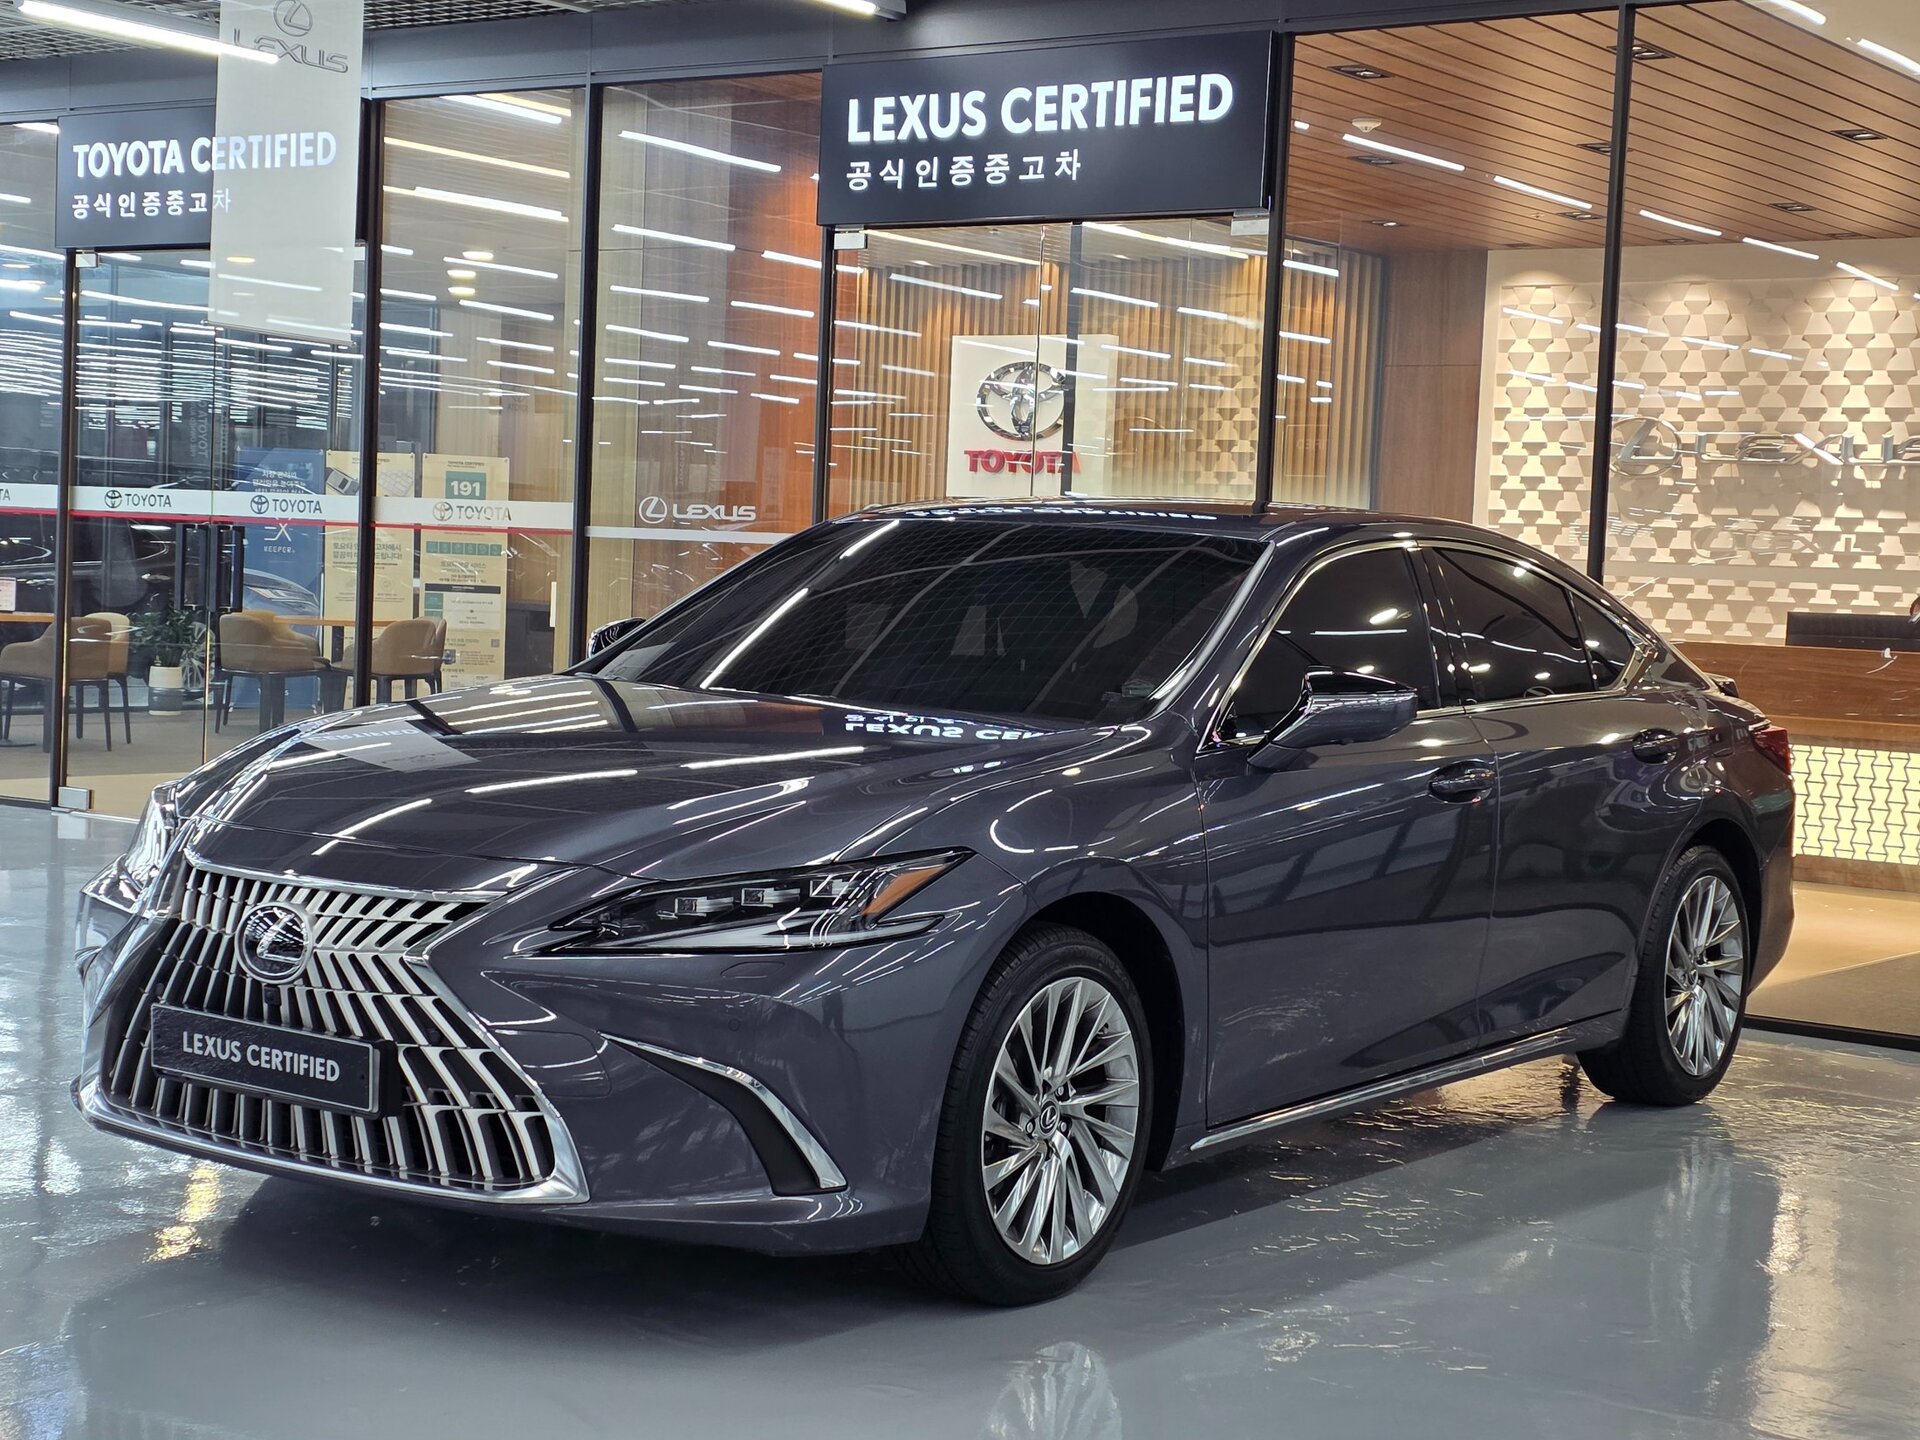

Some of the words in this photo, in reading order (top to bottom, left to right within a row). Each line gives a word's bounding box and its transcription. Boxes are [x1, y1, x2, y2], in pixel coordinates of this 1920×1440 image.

[847, 90, 987, 144] LEXUS
[1000, 73, 1234, 134] CERTIFIED
[72, 139, 185, 178] TOYOTA
[190, 131, 337, 173] CERTIFIED
[846, 148, 1082, 192] 공식인증중고차
[71, 187, 232, 220] 공식인증중고차
[124, 493, 172, 508] TOYOTA
[450, 480, 481, 497] 191
[271, 498, 323, 514] TOYOTA
[456, 505, 512, 521] TOYOTA
[672, 503, 757, 522] LEXUS
[182, 1031, 243, 1063] LEXUS
[246, 1044, 341, 1083] CERTIFIED
